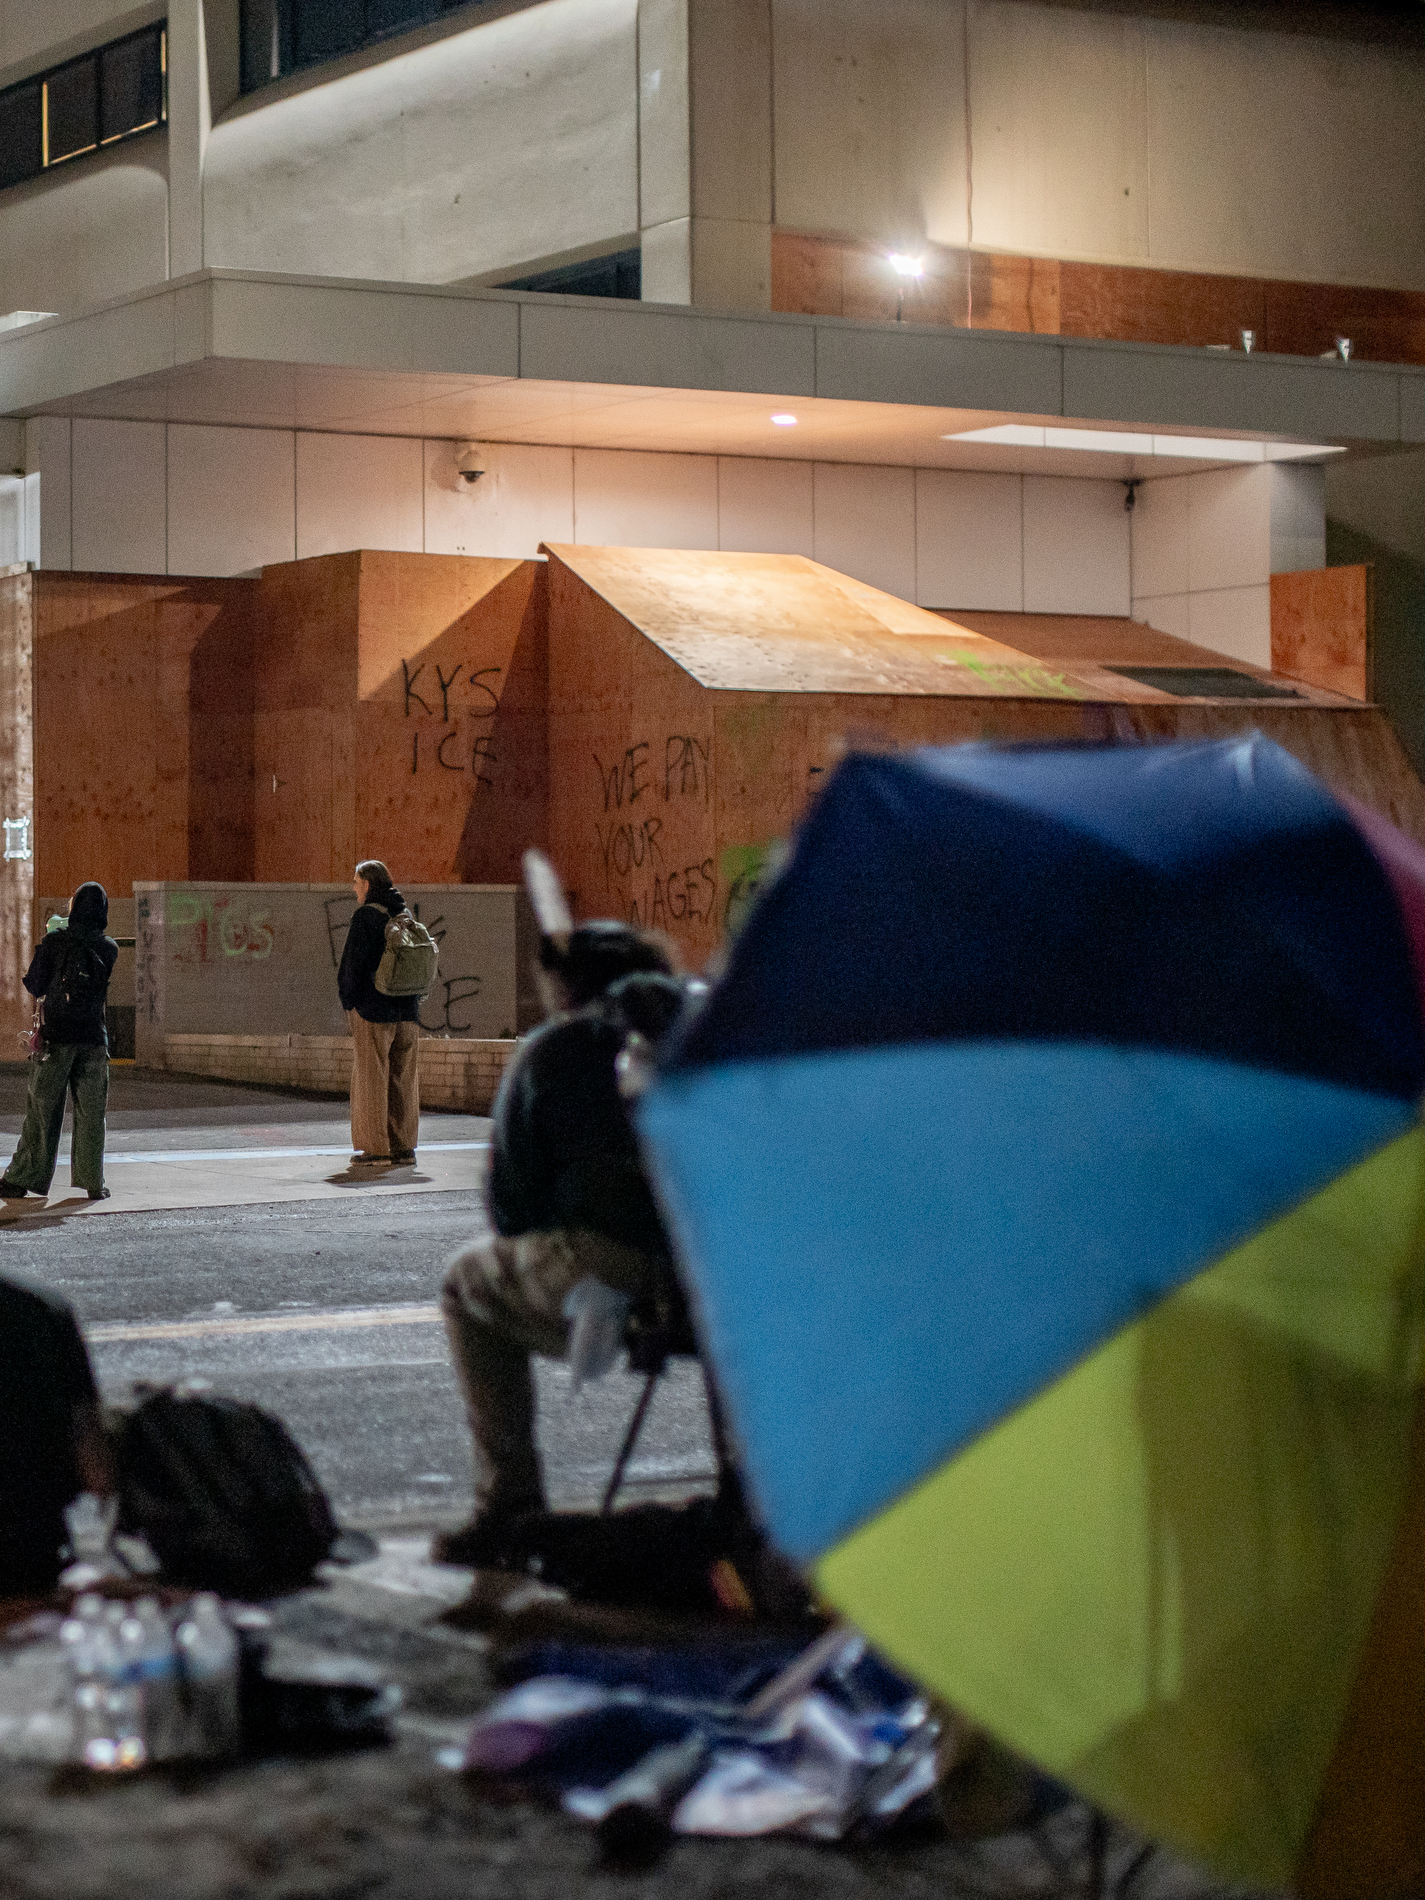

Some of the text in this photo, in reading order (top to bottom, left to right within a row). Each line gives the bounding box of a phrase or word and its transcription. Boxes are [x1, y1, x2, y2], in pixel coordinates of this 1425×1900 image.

[401, 658, 501, 722] KYS
[411, 731, 498, 784] ICE
[592, 735, 711, 812] WE PAY
[595, 817, 665, 893] YOUR
